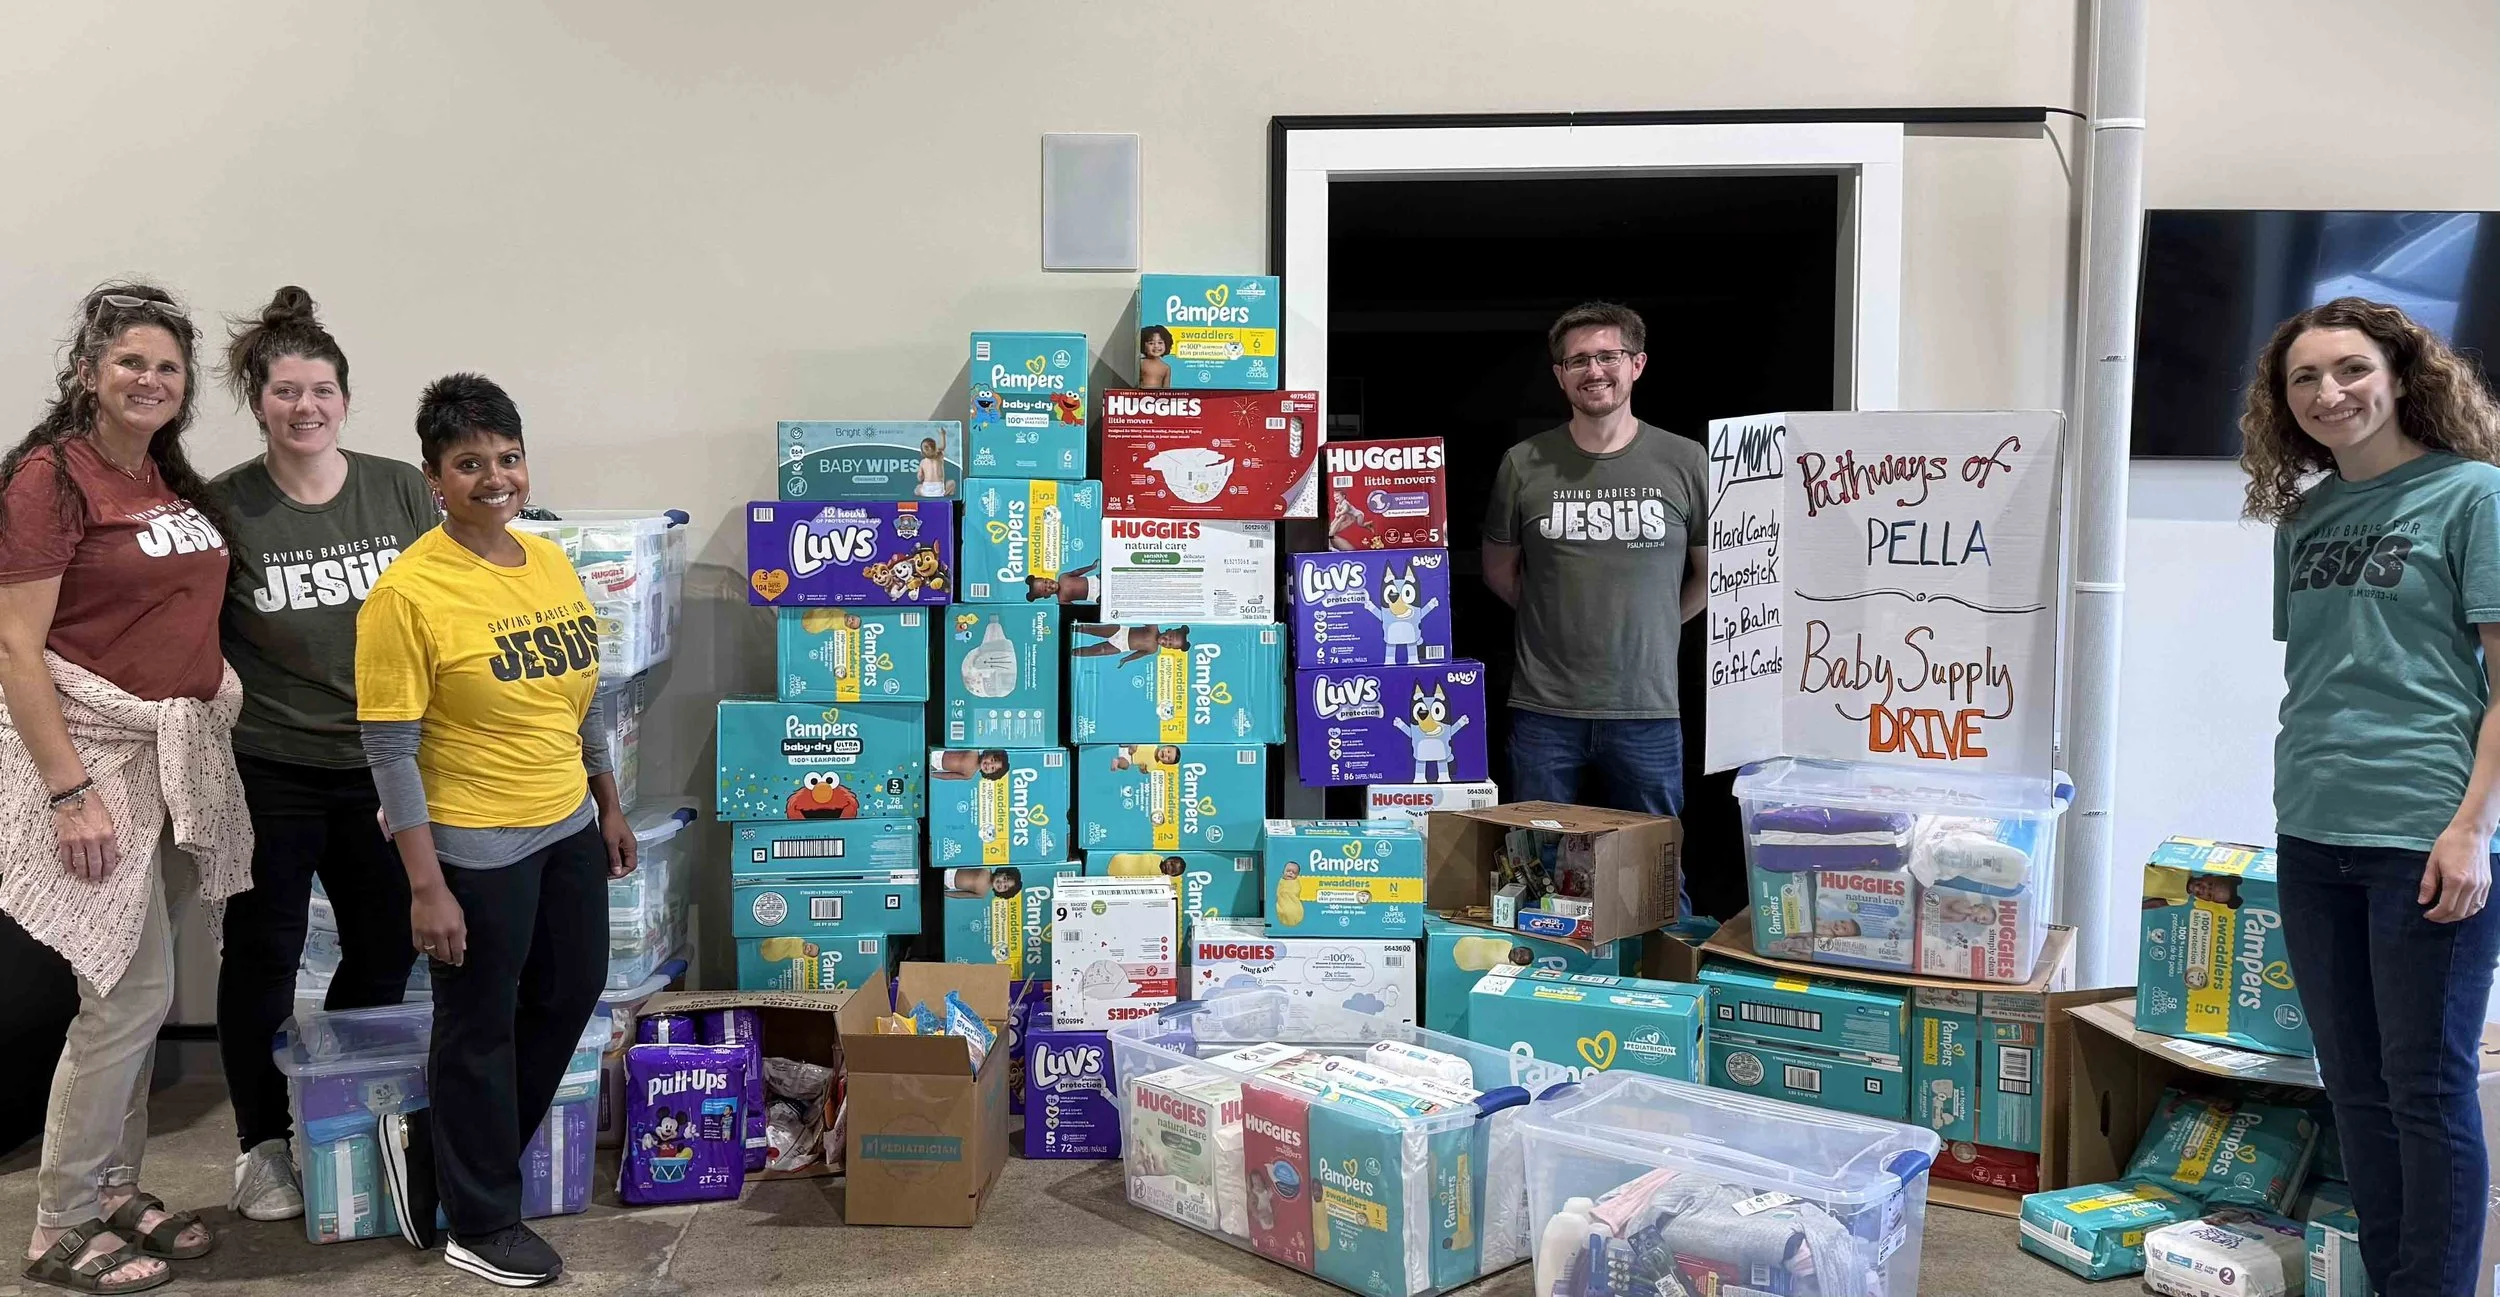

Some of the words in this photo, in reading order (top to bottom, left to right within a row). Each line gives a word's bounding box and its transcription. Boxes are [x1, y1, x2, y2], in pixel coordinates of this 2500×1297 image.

[1166, 295, 1249, 326] Pampers
[1181, 331, 1234, 340] swaddlers
[1253, 339, 1261, 349] 6
[991, 364, 1064, 391] Pampers
[1108, 396, 1202, 416] HUGGIES
[835, 427, 861, 438] Bright
[820, 459, 863, 473] BABY
[866, 459, 920, 473] WIPES
[1064, 450, 1072, 461] 6
[1327, 446, 1441, 473] HUGGIES
[1711, 424, 1734, 492] 4
[1733, 424, 1786, 477] MOMS
[1364, 476, 1392, 486] little
[1394, 475, 1436, 485] movers
[1797, 449, 1948, 517] Pathways
[1962, 436, 2021, 488] of
[1040, 492, 1049, 500] 5
[1126, 494, 1134, 504] 5
[1553, 489, 1591, 499] SAVING
[1597, 488, 1636, 499] BABIES
[1642, 488, 1662, 498] FOR
[837, 507, 867, 518] hours
[1539, 500, 1666, 541] JESUS
[1111, 520, 1200, 540] HUGGIES
[1428, 529, 1439, 542] 5
[1713, 511, 1746, 550] Hard
[1746, 509, 1780, 556] Candy
[2392, 520, 2421, 536] FOR
[263, 549, 314, 564] SAVING
[321, 539, 370, 559] BABIES
[375, 535, 398, 548] FOR
[793, 525, 873, 574] Luvs
[997, 500, 1024, 583] Pampers
[1032, 515, 1041, 568] swaddlers
[1125, 541, 1163, 550] natural
[1165, 543, 1187, 551] care
[1867, 517, 1992, 566] PELLA
[762, 571, 768, 580] 3
[2291, 535, 2414, 592] ESUS
[1302, 562, 1364, 603] Luvs
[1240, 606, 1257, 614] 560
[1326, 595, 1366, 604] protection
[488, 614, 531, 633] SAVING
[1036, 611, 1047, 642] Pampers
[1713, 603, 1736, 651] Lip
[1740, 602, 1780, 634] Balm
[489, 615, 600, 682] JESUS
[863, 623, 884, 687] Pampers
[1316, 647, 1325, 658] 6
[1329, 656, 1339, 664] 74
[1713, 652, 1748, 686] Gift
[1750, 650, 1782, 676] Cards
[1800, 620, 1893, 721] Baby
[1897, 626, 2014, 720] Supply
[1191, 643, 1221, 725] Pampers
[1316, 678, 1378, 717] Luvs
[1340, 709, 1380, 717] protection
[785, 714, 858, 740] Pampers
[1869, 703, 1988, 760] DRIVE
[1331, 764, 1339, 773] 5
[891, 780, 899, 789] 5
[890, 797, 900, 805] 78
[1009, 768, 1038, 846] Pampers
[1180, 763, 1206, 834] Pampers
[1372, 793, 1433, 806] HUGGIES
[990, 847, 999, 855] 6
[1310, 849, 1379, 875] Pampers
[1184, 871, 1212, 922] Pamp
[1390, 883, 1398, 892] N
[1821, 872, 1905, 897] HUGGIES
[1845, 893, 1881, 904] natural
[1883, 898, 1905, 906] care
[1023, 886, 1051, 965] Pampers
[1768, 895, 1783, 934] Pampers
[1997, 900, 2018, 978] HUGGIES
[2170, 913, 2179, 944] protection
[1199, 944, 1276, 960] HUGGIES
[1988, 928, 1997, 957] simply
[2190, 928, 2199, 965] protection
[2213, 915, 2228, 990] swaddlers
[1330, 953, 1355, 962] 100%
[1989, 957, 1997, 977] clean
[2236, 908, 2282, 1010] Pampers
[821, 950, 842, 991] Pamp
[1107, 1008, 1160, 1021] UGGIES
[2168, 997, 2177, 1010] 58
[2205, 1004, 2220, 1015] 5
[1626, 1043, 1674, 1055] PEDIATRICIAN
[1941, 1020, 1959, 1067] Pampers
[1035, 1045, 1101, 1087] Luvs
[1060, 1080, 1102, 1089] protection
[1136, 1086, 1206, 1127] HUGGIES
[1045, 1131, 1056, 1145] 5
[1157, 1118, 1187, 1135] natural
[1188, 1127, 1207, 1141] care
[1245, 1113, 1302, 1147] HUGGIES
[1060, 1144, 1073, 1153] 72
[2212, 1112, 2263, 1176] Pampers
[699, 1175, 729, 1184] 2T-3T
[1319, 1158, 1374, 1197] Pampers
[1184, 1200, 1198, 1213] 560
[1325, 1191, 1368, 1211] swaddlers
[1444, 1175, 1457, 1229] Pampers
[1375, 1208, 1380, 1219] 1
[2224, 1270, 2231, 1282] 2
